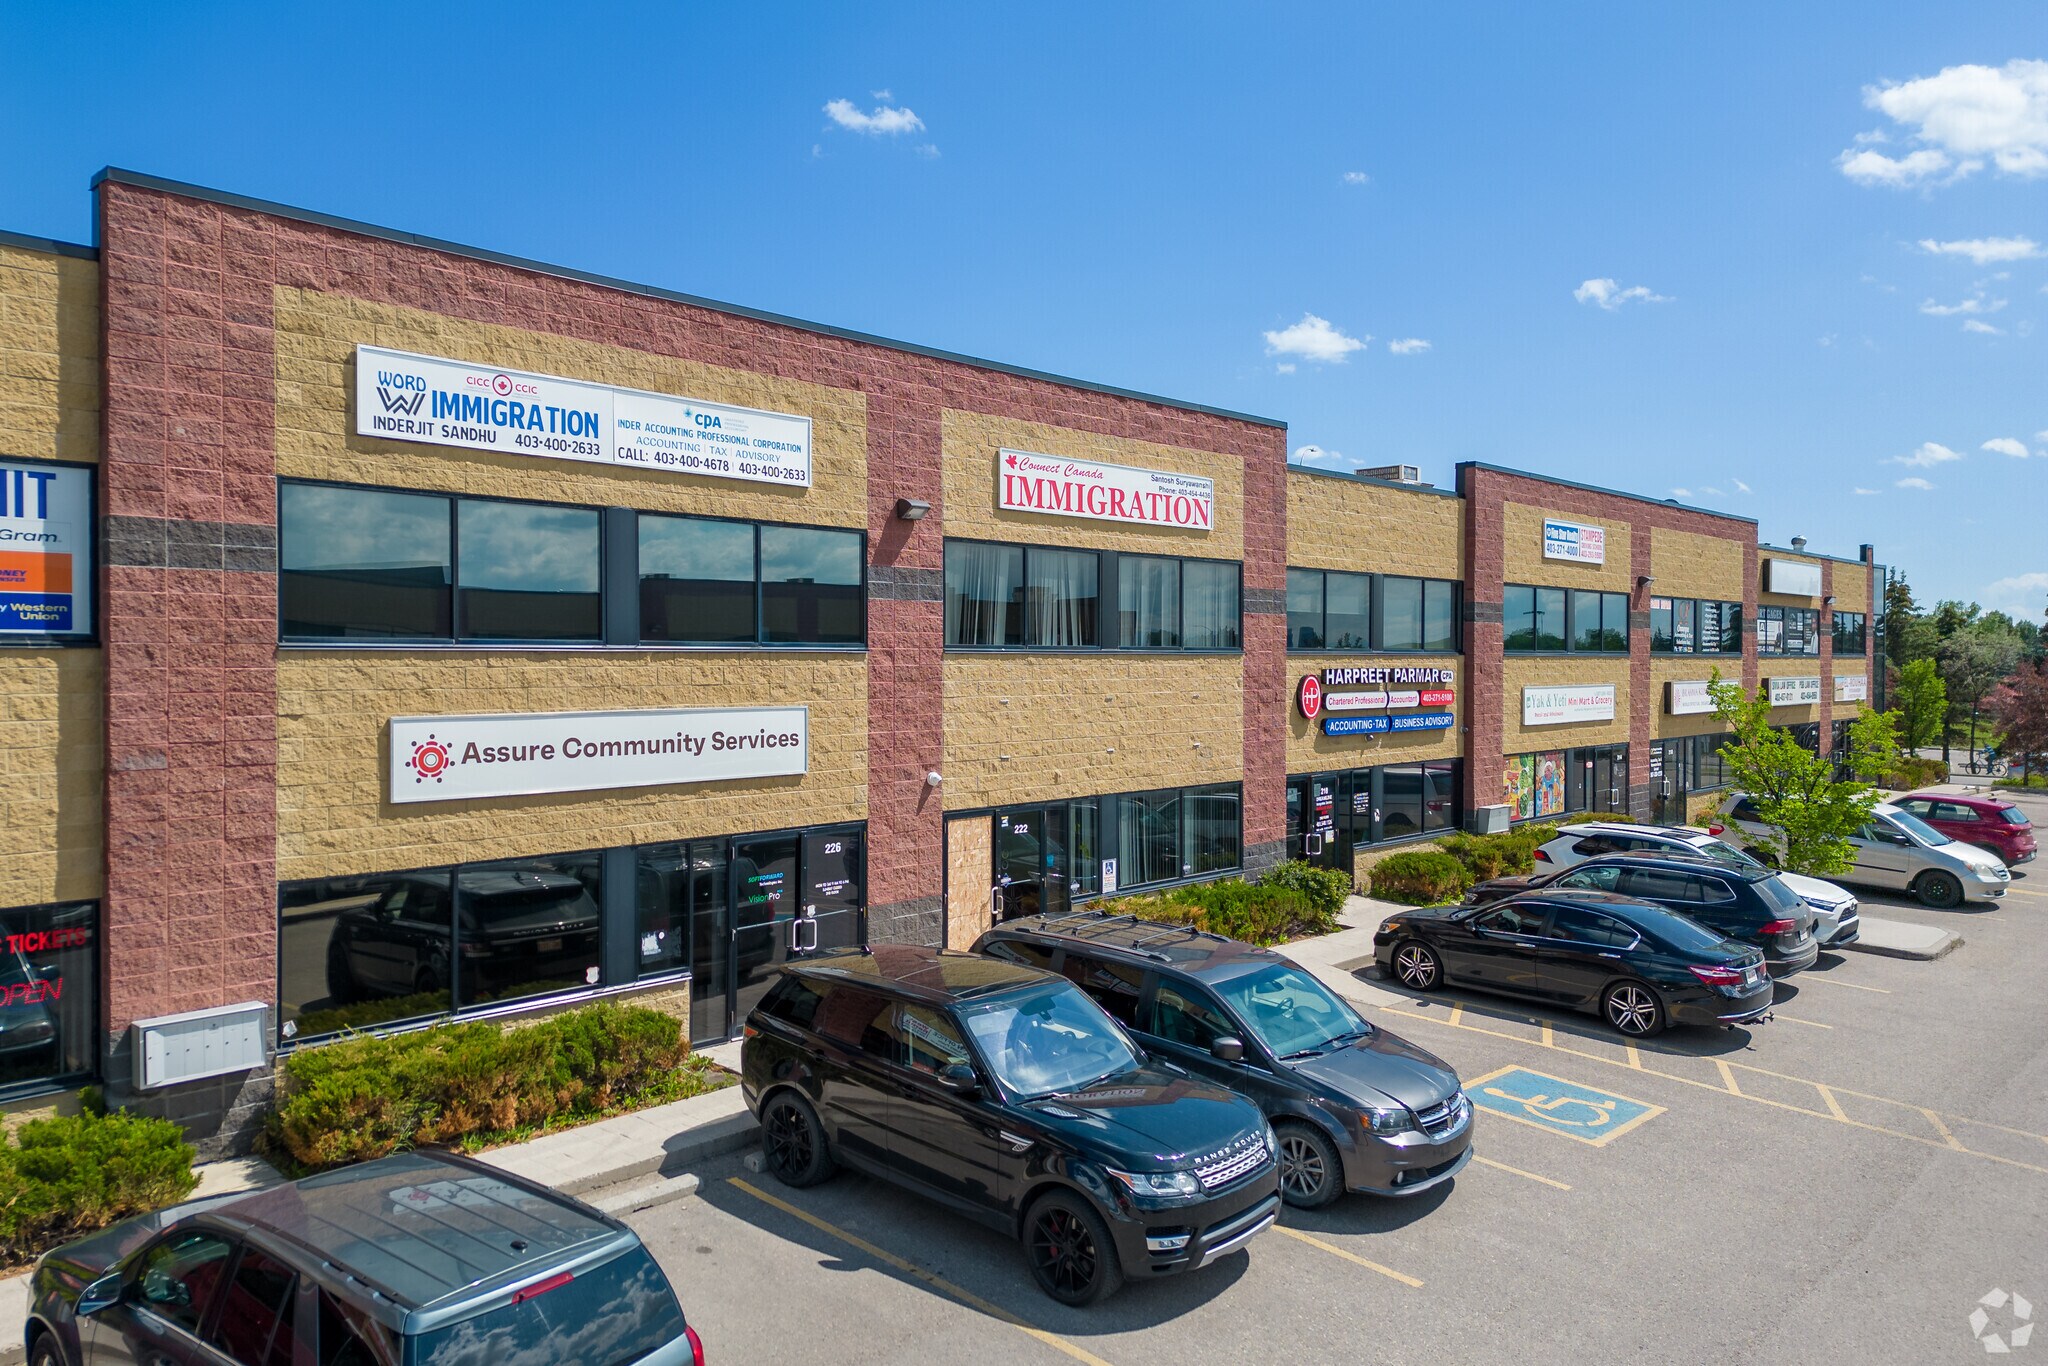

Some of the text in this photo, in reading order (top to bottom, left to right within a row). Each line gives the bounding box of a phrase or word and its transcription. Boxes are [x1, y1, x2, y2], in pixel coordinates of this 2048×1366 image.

[378, 370, 427, 392] WORD
[466, 376, 538, 395] CICC CCIC
[431, 389, 599, 439] IMMIGRATION
[373, 415, 435, 436] INDERJIT
[441, 425, 497, 443] SANDHU
[617, 419, 802, 453] INDER ACCOUNTING PROFESSIONAL CORPORATION
[618, 446, 649, 462] CALL:
[636, 436, 781, 463] ACCOUNTING TAX ADVISORY
[1018, 456, 1104, 479] Connect Canada
[1151, 474, 1175, 485] Santosh
[1003, 473, 1211, 527] IMMIGRATION
[10, 602, 68, 612] Western
[20, 611, 60, 620] Union
[1325, 668, 1391, 685] HARPREET
[1394, 668, 1439, 683] PARMAR
[1328, 696, 1354, 706] Chartered
[1354, 695, 1386, 705] Professional
[1390, 695, 1418, 703] Accountant
[1531, 694, 1545, 709] Yak
[1546, 694, 1552, 707] &
[1553, 693, 1567, 707] Yeti
[1567, 697, 1578, 706] Mini
[1579, 697, 1590, 706] Mart
[1595, 696, 1613, 706] Grocery
[1330, 720, 1373, 731] ACCOUNTING
[1394, 717, 1424, 728] BUSINESS
[1424, 716, 1453, 726] ADVISORY
[460, 728, 800, 766] Assure Community Services
[1014, 823, 1028, 834] 222
[824, 842, 842, 854] 226
[748, 892, 781, 903] VisionPro
[5, 927, 87, 954] TICKETS
[1193, 1129, 1261, 1164] RANGE ROVER
